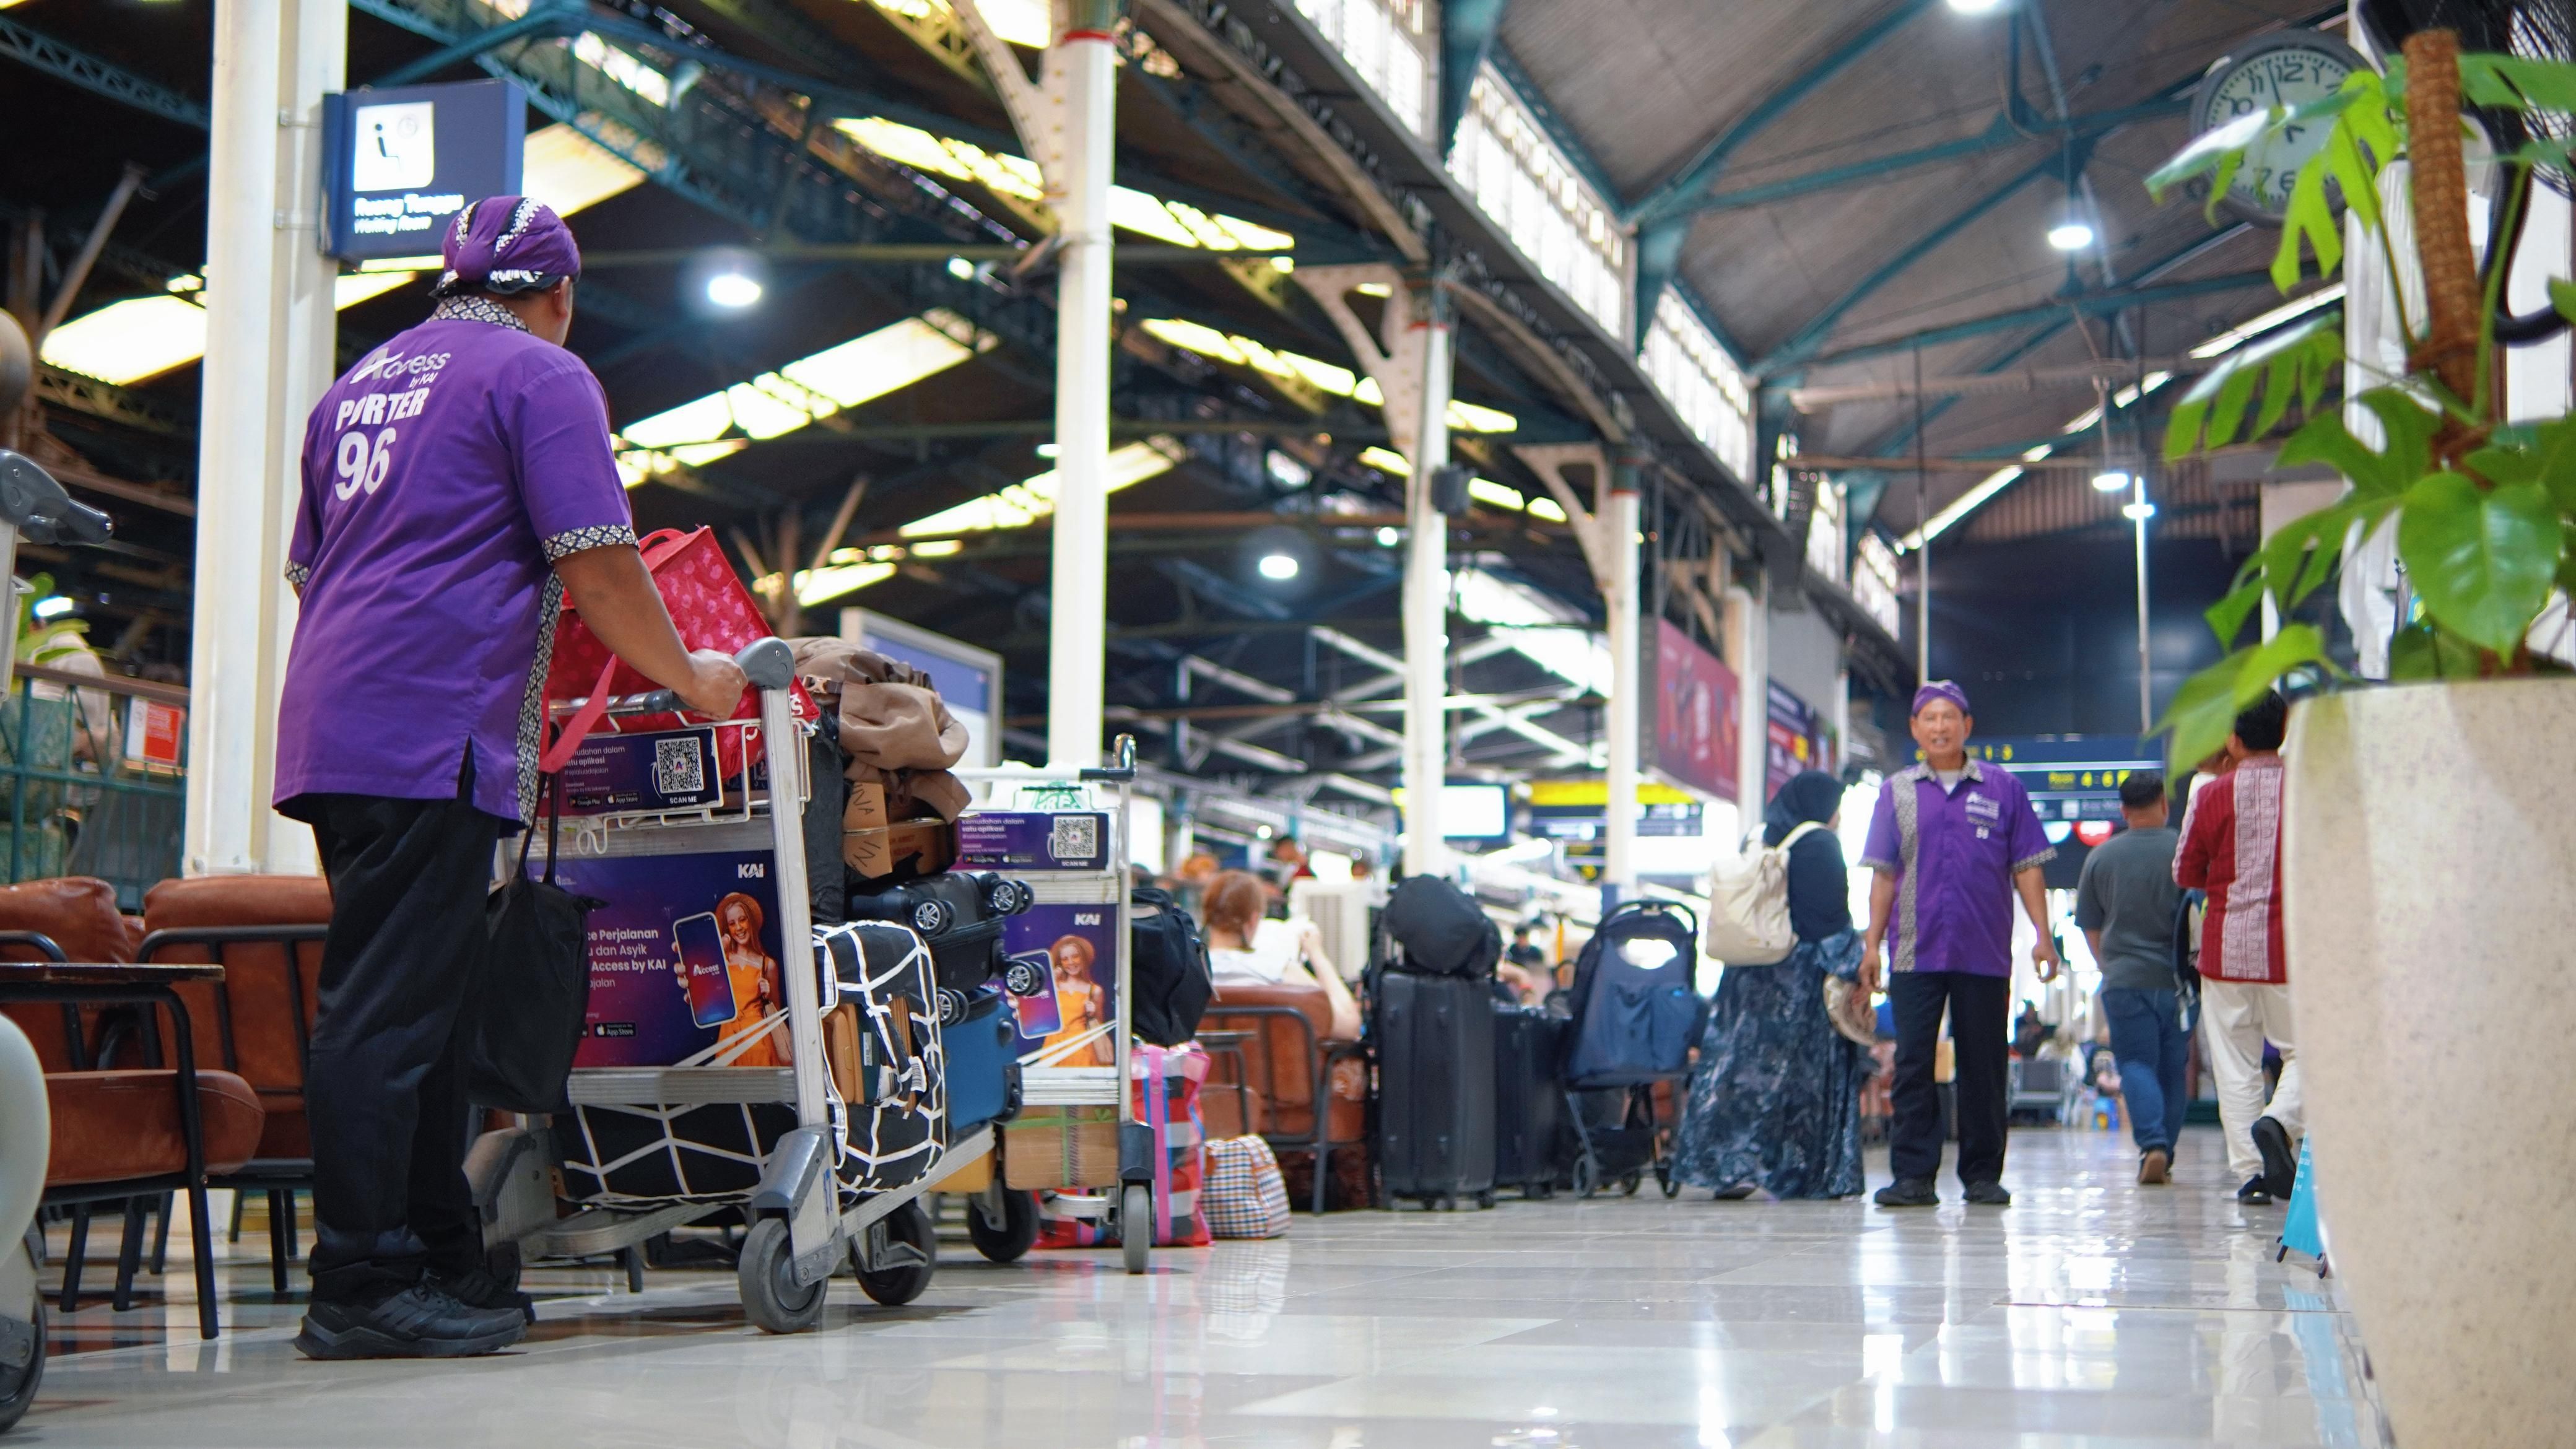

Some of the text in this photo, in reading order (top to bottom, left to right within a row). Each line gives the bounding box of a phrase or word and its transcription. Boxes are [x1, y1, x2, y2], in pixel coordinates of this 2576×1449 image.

[2276, 63, 2304, 82] 12
[2248, 67, 2264, 94] 11
[409, 372, 438, 388] by KAI
[335, 387, 430, 432] PORTER
[335, 427, 396, 501] 96
[603, 745, 625, 754] dalam
[578, 755, 605, 767] aplikasi
[669, 796, 687, 804] SCAN
[738, 863, 764, 879] KAI
[1074, 913, 1101, 926] KAI
[599, 928, 659, 944] Perjalanan
[596, 944, 617, 956] dan
[619, 943, 647, 958] Asyik
[591, 959, 667, 974] Access by KAI
[606, 1027, 634, 1037] App Store
